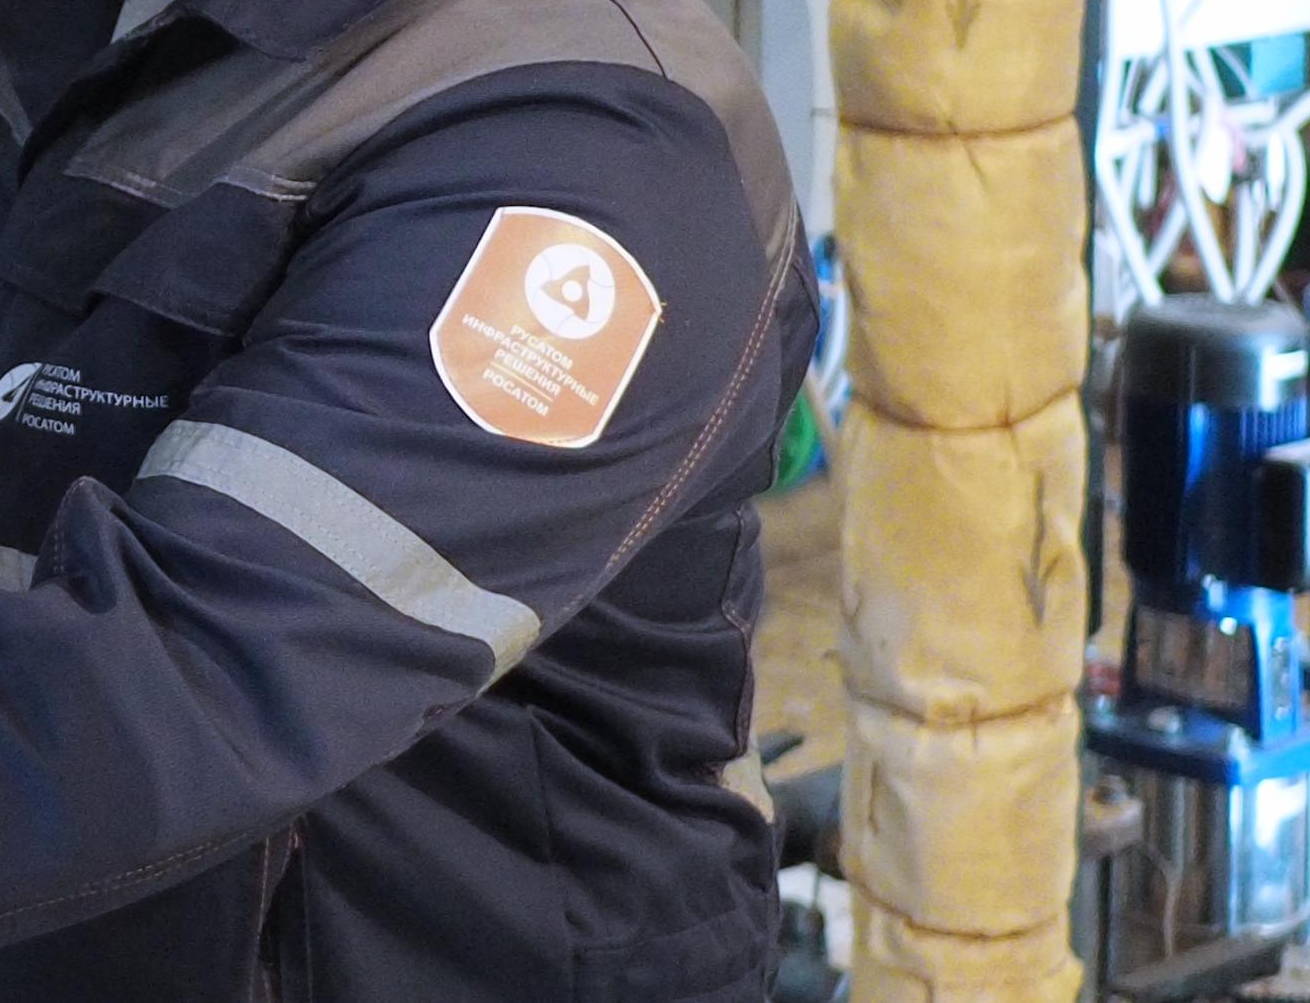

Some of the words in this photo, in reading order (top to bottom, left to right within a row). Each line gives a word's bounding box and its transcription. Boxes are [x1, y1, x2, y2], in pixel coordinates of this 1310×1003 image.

[461, 313, 600, 406] ИНФРАСТРУКТУРНЫЕ
[510, 324, 573, 370] РУСАТОМ
[483, 368, 549, 416] РОСАТОМ
[494, 348, 562, 396] РЕШЕНИЯ
